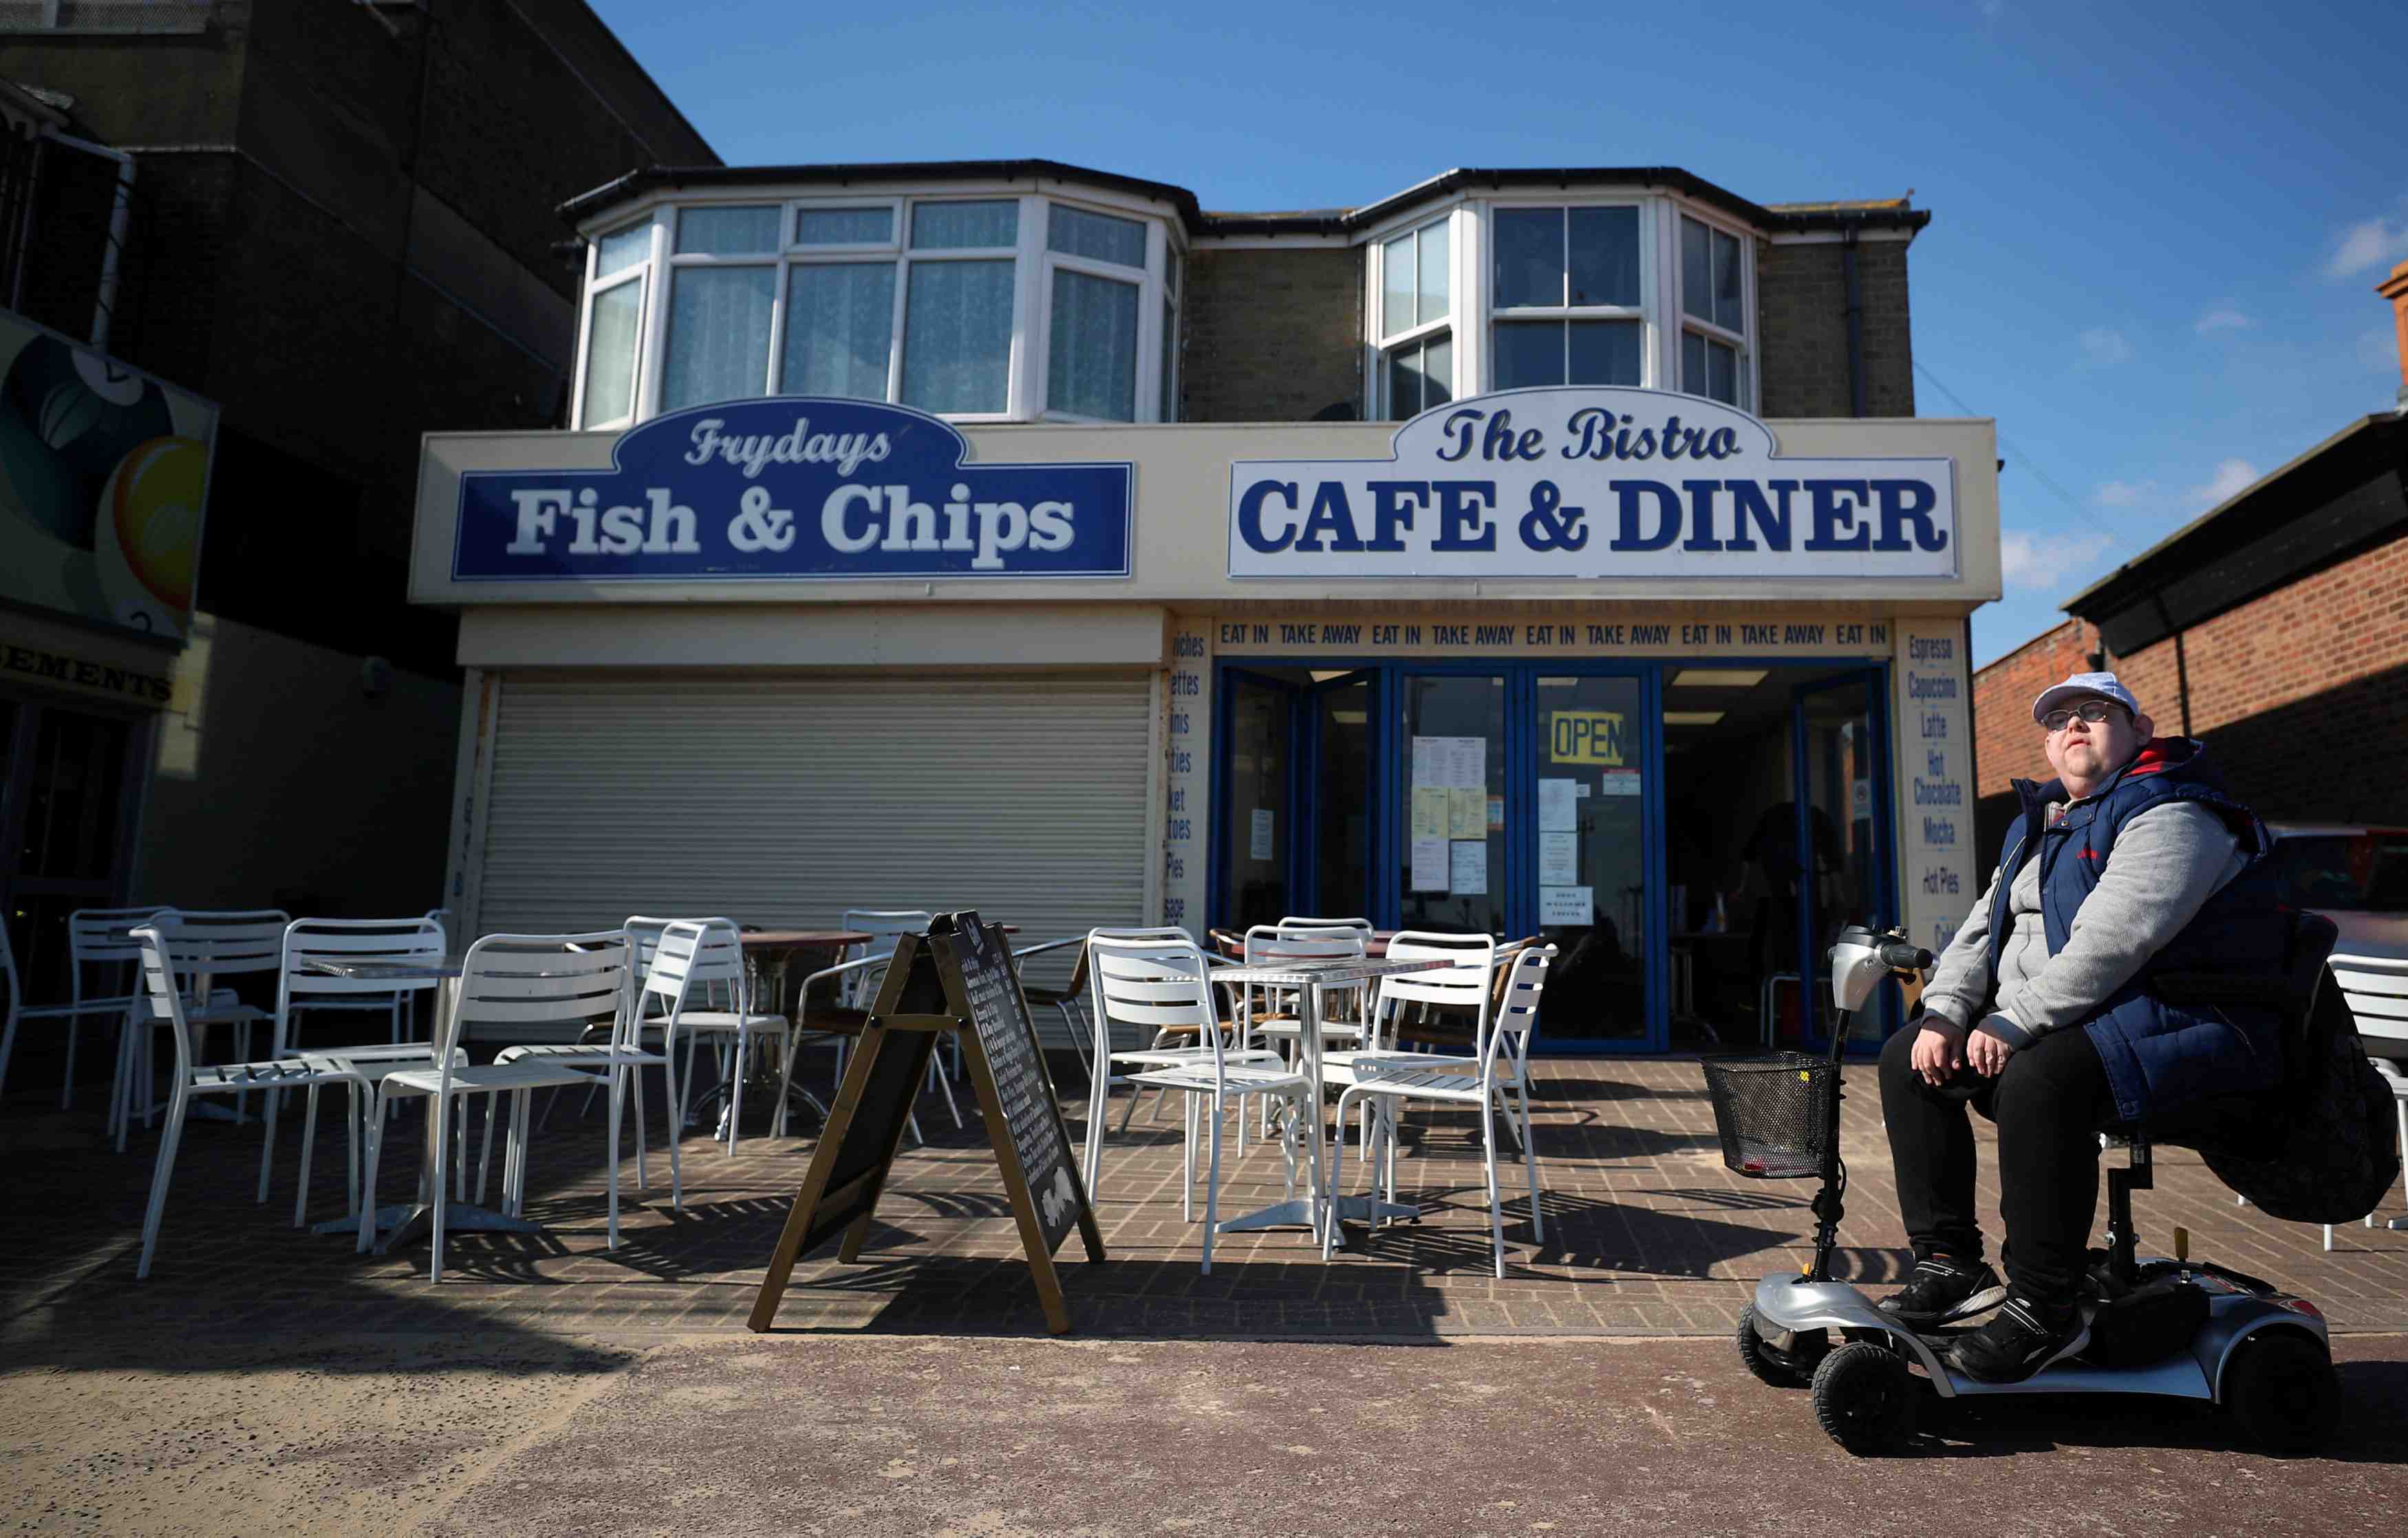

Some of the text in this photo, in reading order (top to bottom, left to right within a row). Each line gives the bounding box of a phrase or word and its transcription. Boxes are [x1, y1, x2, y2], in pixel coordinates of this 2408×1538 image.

[684, 417, 890, 478] Frydays
[1435, 407, 1743, 462] The Bistro
[506, 482, 1075, 570] Fish & Chips
[1237, 479, 1948, 554] CAFE & DINER
[1221, 624, 1886, 645] EAT IN TAKE AWAY EAT IN TAKE AWAY EAT IN TAKE AWAY EAT IN TAKE AWAY EAT IN
[1909, 634, 1953, 666] Espresso
[0, 643, 171, 701] EMENTS
[1554, 717, 1623, 758] OPEN
[1921, 711, 1947, 738] Latte
[1927, 748, 1945, 777] Hot
[1914, 776, 1961, 805] Chocolate
[1924, 816, 1955, 845] Mocha
[1940, 866, 1960, 894] Pies
